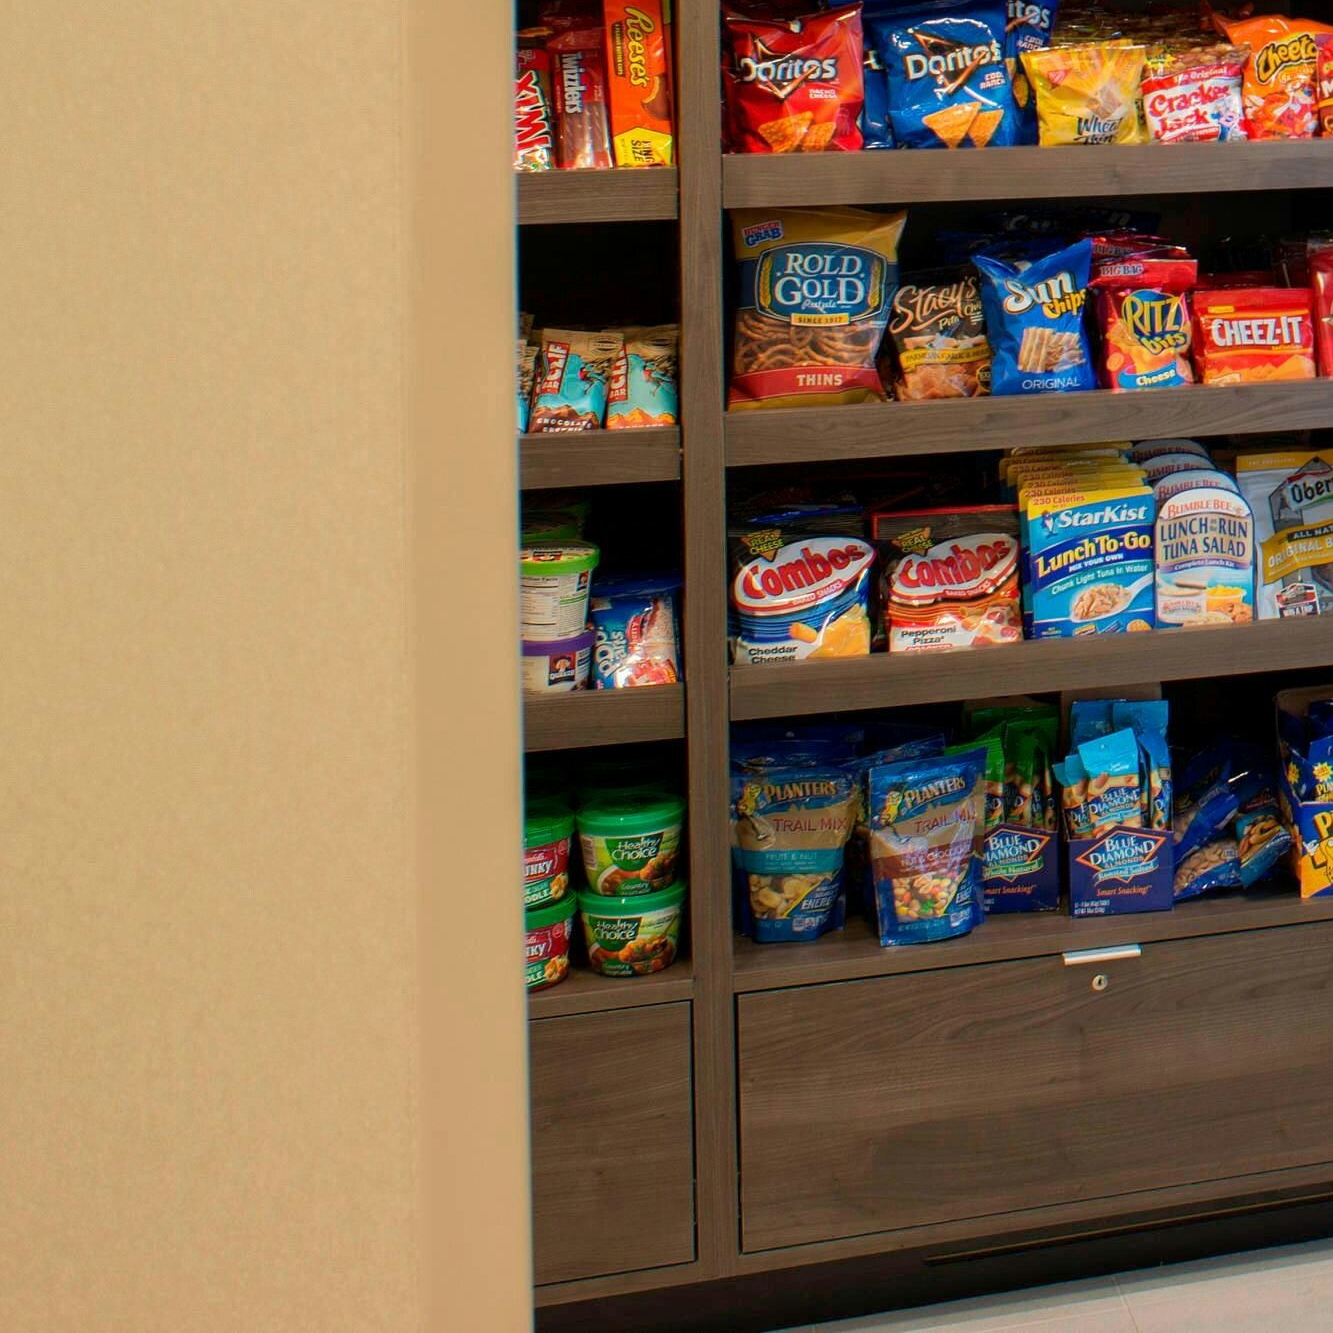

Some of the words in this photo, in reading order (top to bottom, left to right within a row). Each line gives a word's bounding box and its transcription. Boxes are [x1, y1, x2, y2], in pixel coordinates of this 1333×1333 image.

[624, 7, 656, 88] Reese's
[740, 56, 837, 83] Doritos
[905, 42, 1002, 81] Doritos
[561, 51, 588, 114] Twizzlers
[1154, 107, 1211, 141] Jack
[783, 252, 863, 278] ROLD
[1100, 265, 1121, 275] BIG
[1123, 264, 1144, 275] BAG
[774, 276, 865, 306] GOLD
[1003, 270, 1076, 315] Sun
[889, 276, 977, 334] Stacy's
[1122, 295, 1182, 334] RITZ
[938, 314, 960, 331] Pita
[1211, 315, 1303, 347] CHEEZ-IT
[1140, 331, 1187, 356] bits
[796, 374, 843, 387] THINS
[1022, 378, 1080, 390] ORIGINAL
[1136, 368, 1176, 386] Cheese
[1033, 498, 1051, 506] 230
[1053, 495, 1085, 504] Calories
[1167, 499, 1211, 519] BUMBLE
[1213, 498, 1233, 510] BEE
[1058, 504, 1148, 529] StarKist
[1160, 516, 1208, 542] LUNCH
[1218, 517, 1248, 539] RUN
[1292, 531, 1313, 540] ALL
[1105, 552, 1124, 562] OWN
[1163, 537, 1199, 561] TUNA
[1203, 536, 1246, 558] SALAD
[1268, 539, 1323, 568] ORIGINAL
[742, 544, 867, 599] Combos
[898, 540, 1012, 588] Combos
[1075, 572, 1095, 585] Light
[901, 626, 957, 638] Pepperoni
[748, 645, 798, 657] Cheddar
[752, 654, 796, 665] Cheese
[761, 781, 837, 803] PLANTERS
[903, 776, 966, 811] PLANTERS
[773, 818, 817, 832] TRAIL
[820, 816, 848, 831] MIX
[617, 836, 660, 852] Healthy
[984, 839, 1041, 863] IAMOND
[989, 834, 1022, 851] BLUE
[1089, 839, 1156, 866] DIAMOND
[1104, 835, 1138, 853] BLUE
[611, 846, 658, 862] Choice
[1096, 886, 1117, 897] Smart
[594, 927, 637, 942] Choice
[596, 916, 639, 932] Healthy
